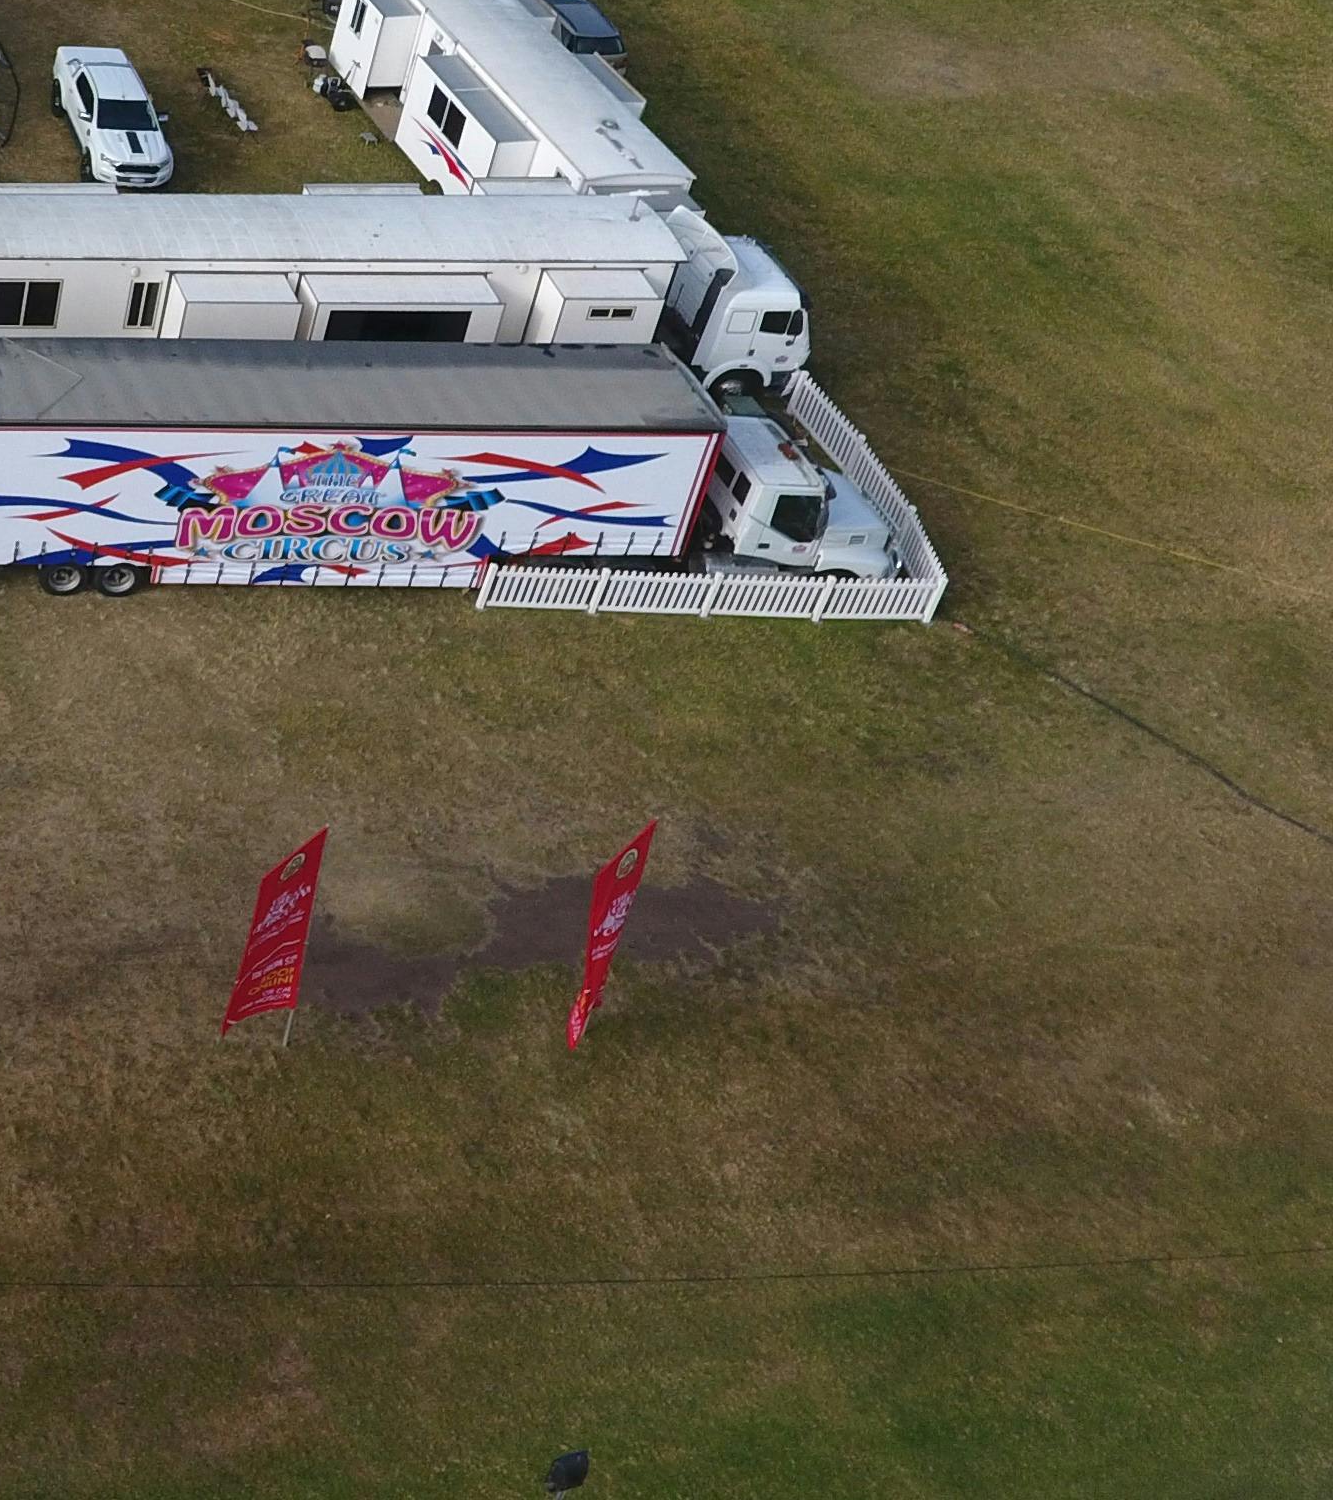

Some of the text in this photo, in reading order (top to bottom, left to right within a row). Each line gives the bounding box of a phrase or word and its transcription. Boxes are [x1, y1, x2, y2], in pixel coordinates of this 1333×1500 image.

[310, 472, 362, 486] THE
[279, 488, 381, 504] GREAT
[175, 503, 481, 550] MOSCOW
[222, 535, 410, 563] CIRCUS
